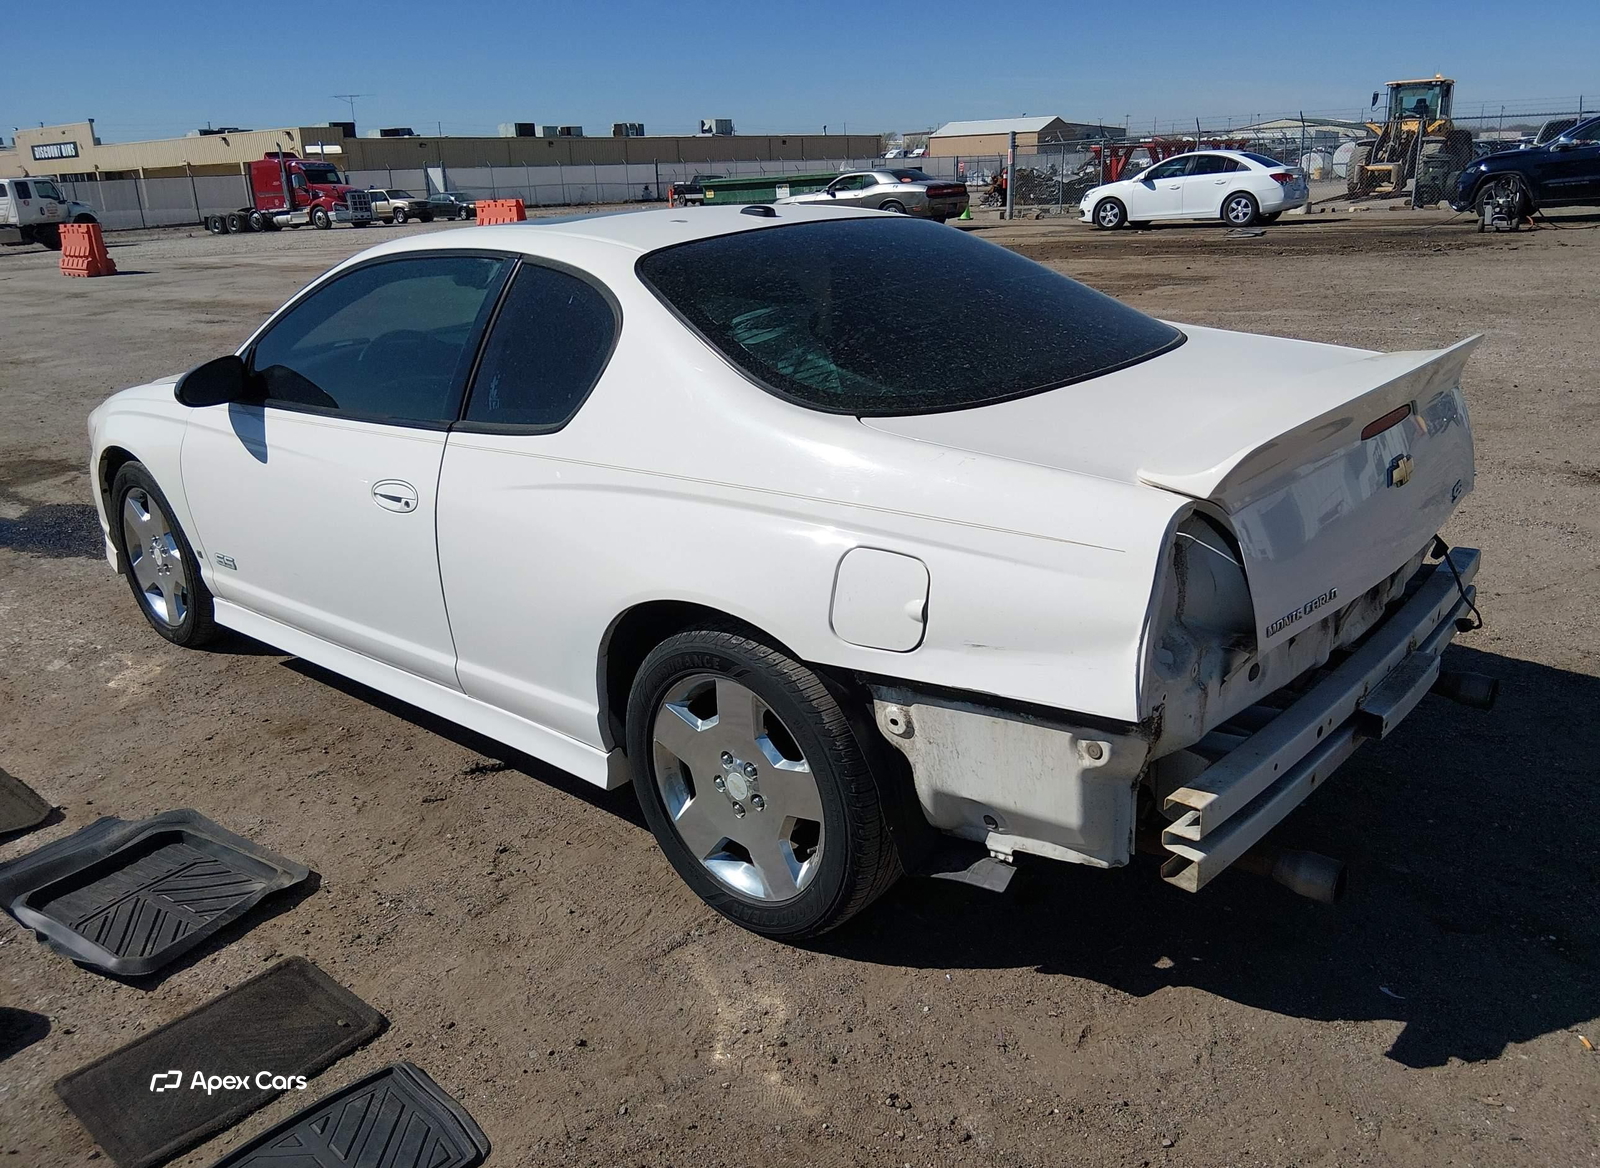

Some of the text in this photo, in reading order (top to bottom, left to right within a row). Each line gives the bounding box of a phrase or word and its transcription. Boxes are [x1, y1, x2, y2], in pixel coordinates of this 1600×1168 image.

[34, 144, 76, 158] DISCOUNT BINS
[1266, 587, 1338, 638] MONTE CARLO
